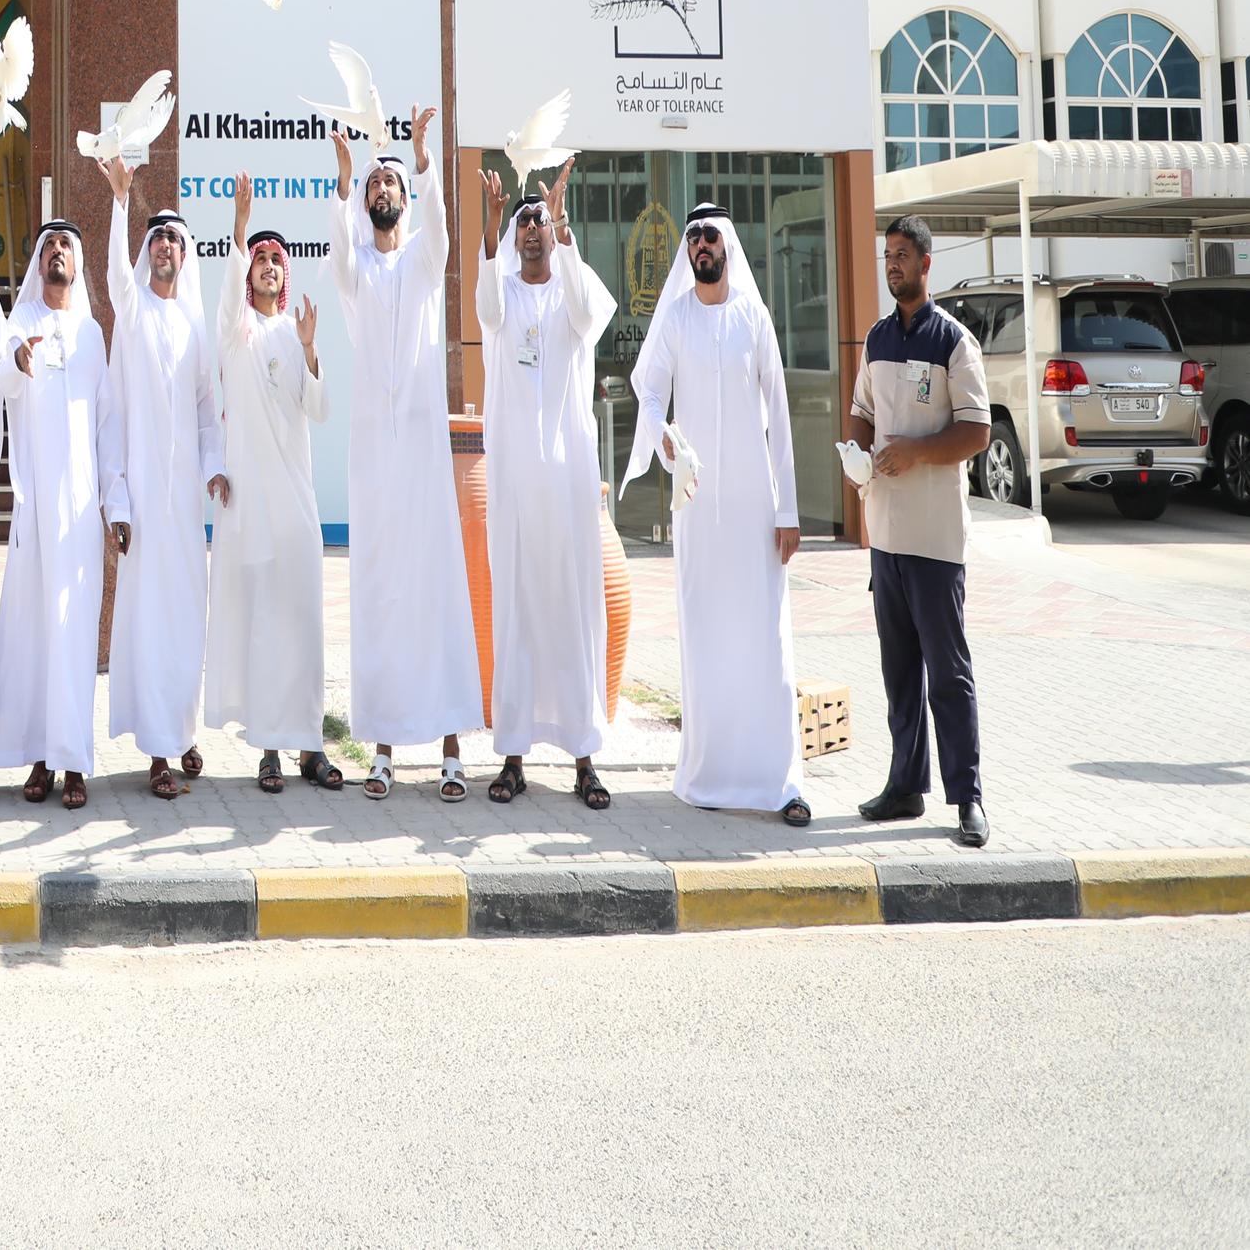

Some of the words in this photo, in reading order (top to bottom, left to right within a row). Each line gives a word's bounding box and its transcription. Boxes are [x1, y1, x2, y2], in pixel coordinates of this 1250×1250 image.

[616, 71, 688, 93] التسامح
[691, 73, 723, 94] عام
[617, 100, 643, 112] YEAR
[647, 100, 660, 112] OF
[664, 100, 724, 113] TOLERANCE
[185, 113, 210, 139] Al
[216, 111, 326, 140] Khaimah
[180, 177, 206, 198] ST
[209, 177, 280, 199] CORT
[285, 178, 306, 199] IN
[1113, 399, 1119, 410] A
[1136, 399, 1150, 410] 540
